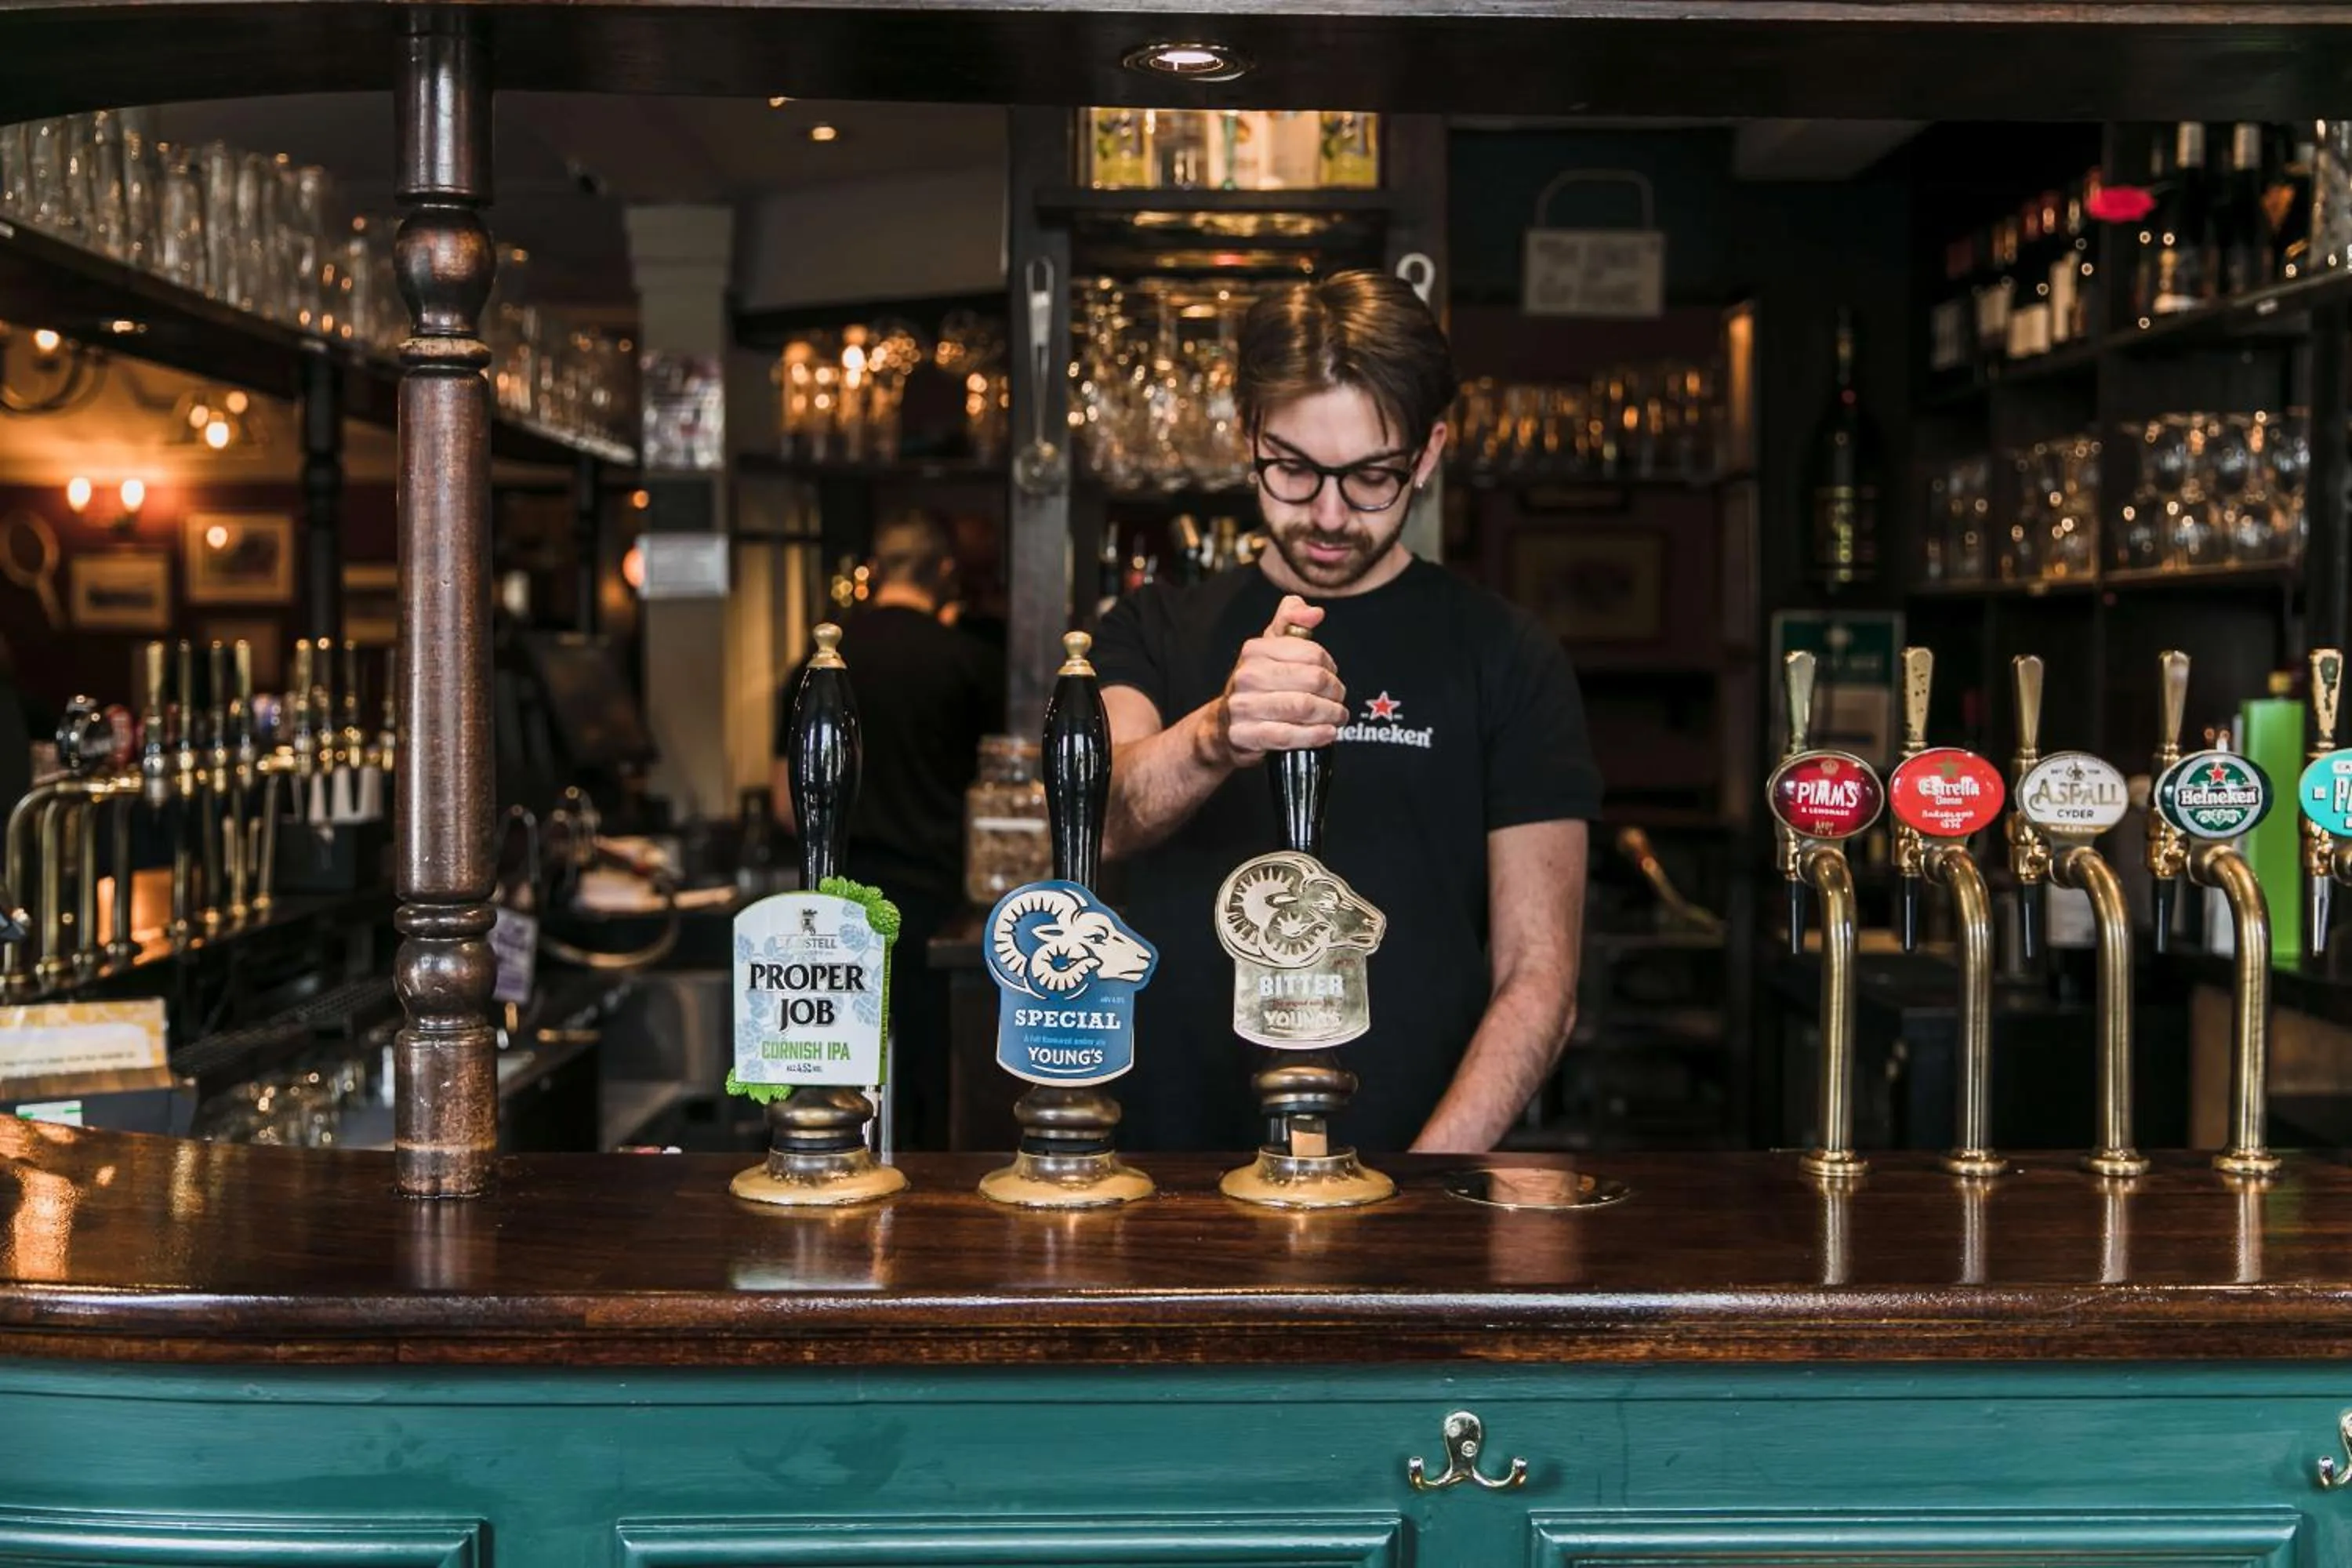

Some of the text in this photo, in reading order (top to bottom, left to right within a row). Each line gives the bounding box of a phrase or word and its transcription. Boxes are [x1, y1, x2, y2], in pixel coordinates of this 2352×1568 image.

[1918, 775, 1980, 797] Estrella
[2029, 779, 2122, 812] ASPALL
[2180, 782, 2256, 805] Heineken
[2056, 809, 2095, 818] CYDER
[793, 937, 837, 949] STELL
[749, 964, 865, 991] PROPER
[1259, 975, 1344, 997] BITTER
[779, 997, 835, 1032] JOB
[1014, 1009, 1121, 1030] SPECIAL
[761, 1040, 851, 1061] CORNISH IPA
[1028, 1047, 1103, 1065] YOUNG'S
